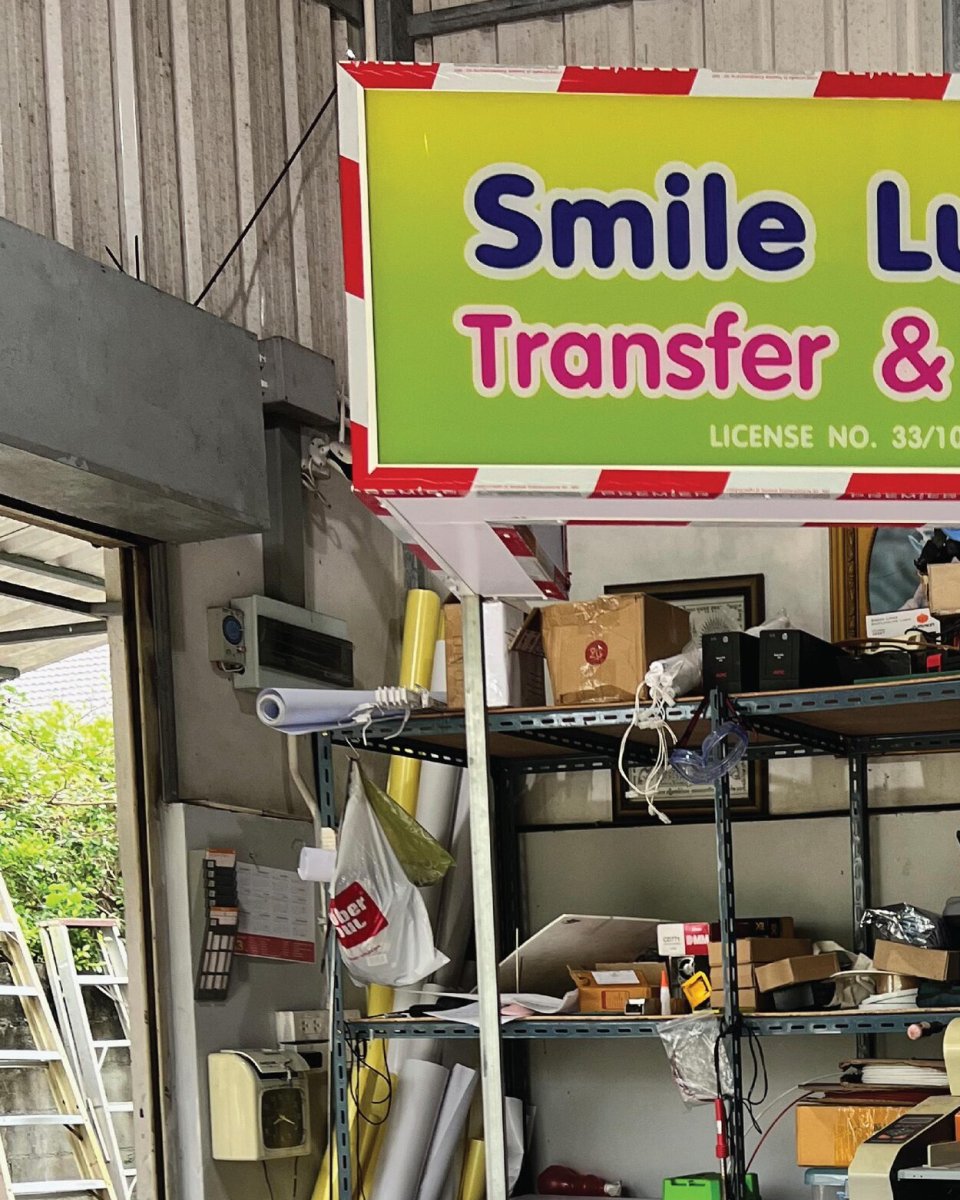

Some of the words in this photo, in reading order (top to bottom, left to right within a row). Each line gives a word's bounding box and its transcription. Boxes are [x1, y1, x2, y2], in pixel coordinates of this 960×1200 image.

[475, 173, 806, 272] Smile
[461, 310, 831, 393] Transfer
[880, 315, 946, 394] &
[710, 424, 814, 449] LICENSE
[828, 424, 877, 449] NO.
